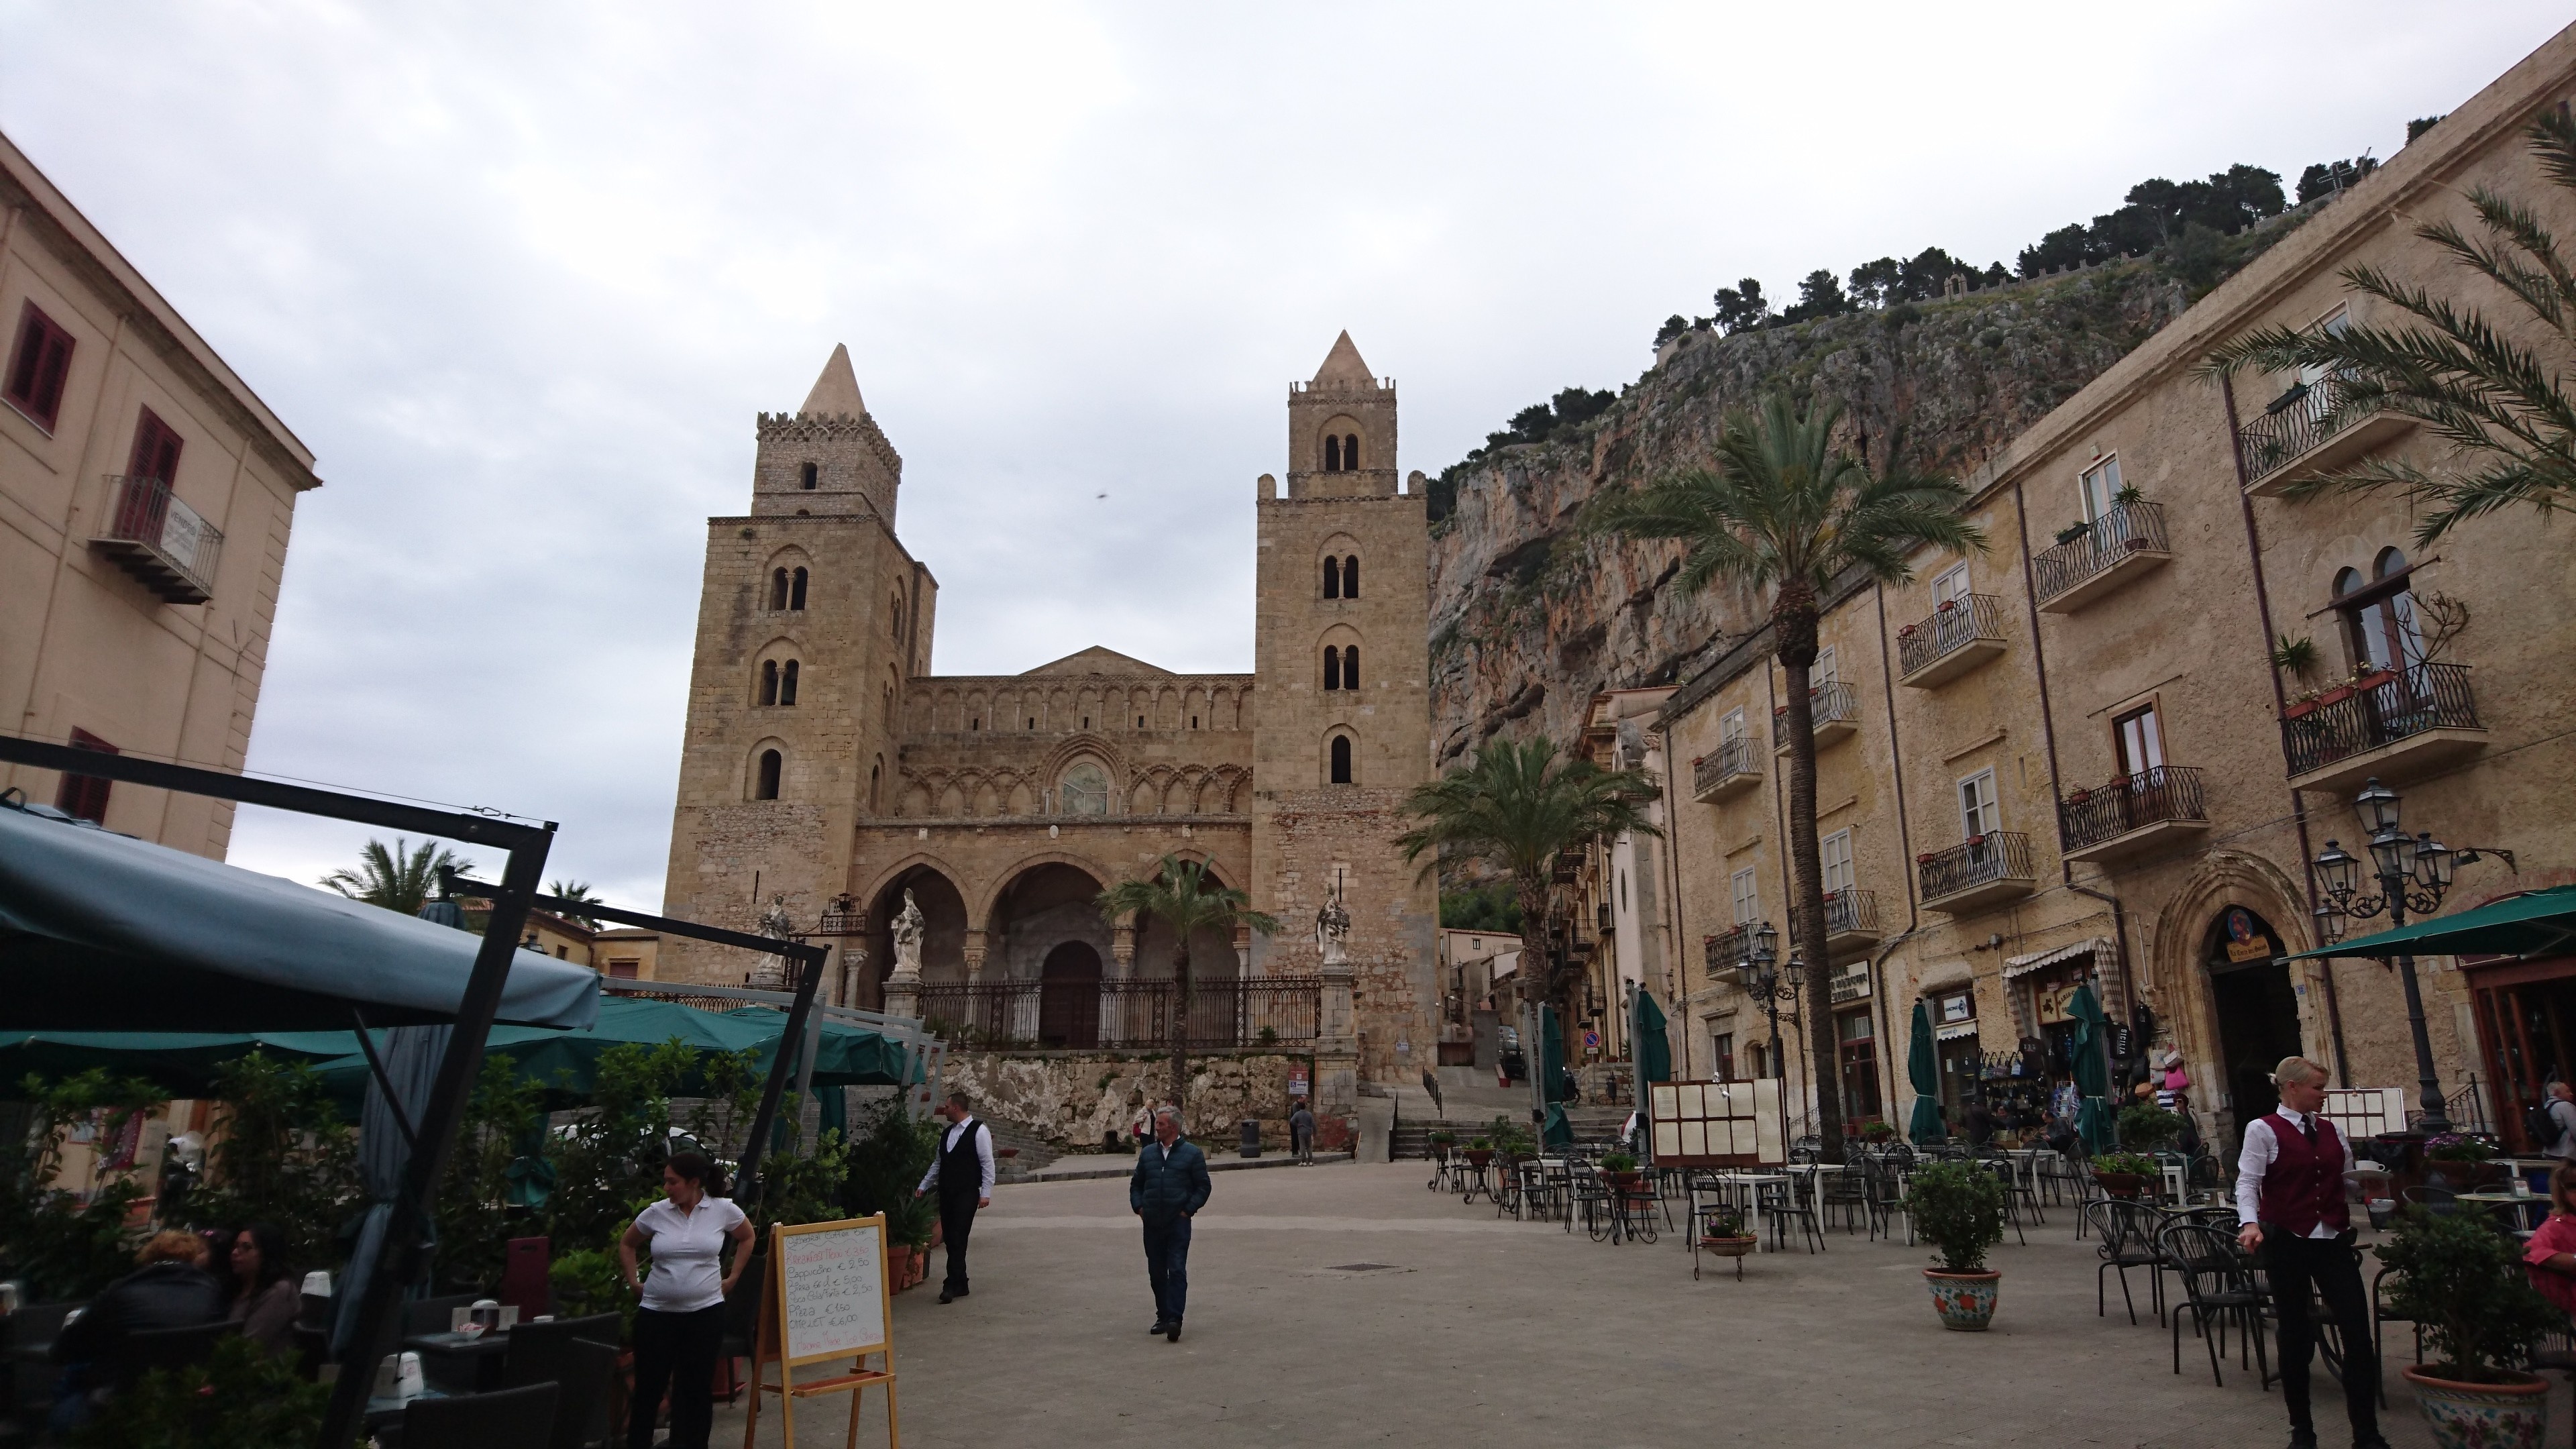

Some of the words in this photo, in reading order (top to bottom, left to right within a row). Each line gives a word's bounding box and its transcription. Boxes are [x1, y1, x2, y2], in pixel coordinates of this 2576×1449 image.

[2119, 1028, 2127, 1055] SICILIA
[824, 1230, 849, 1240] Coffee
[786, 1265, 831, 1281] Cappuccino
[849, 1259, 869, 1271] 2,50
[843, 1275, 862, 1285] 5,00
[853, 1283, 873, 1296] 2,50
[788, 1304, 815, 1316] Pizza
